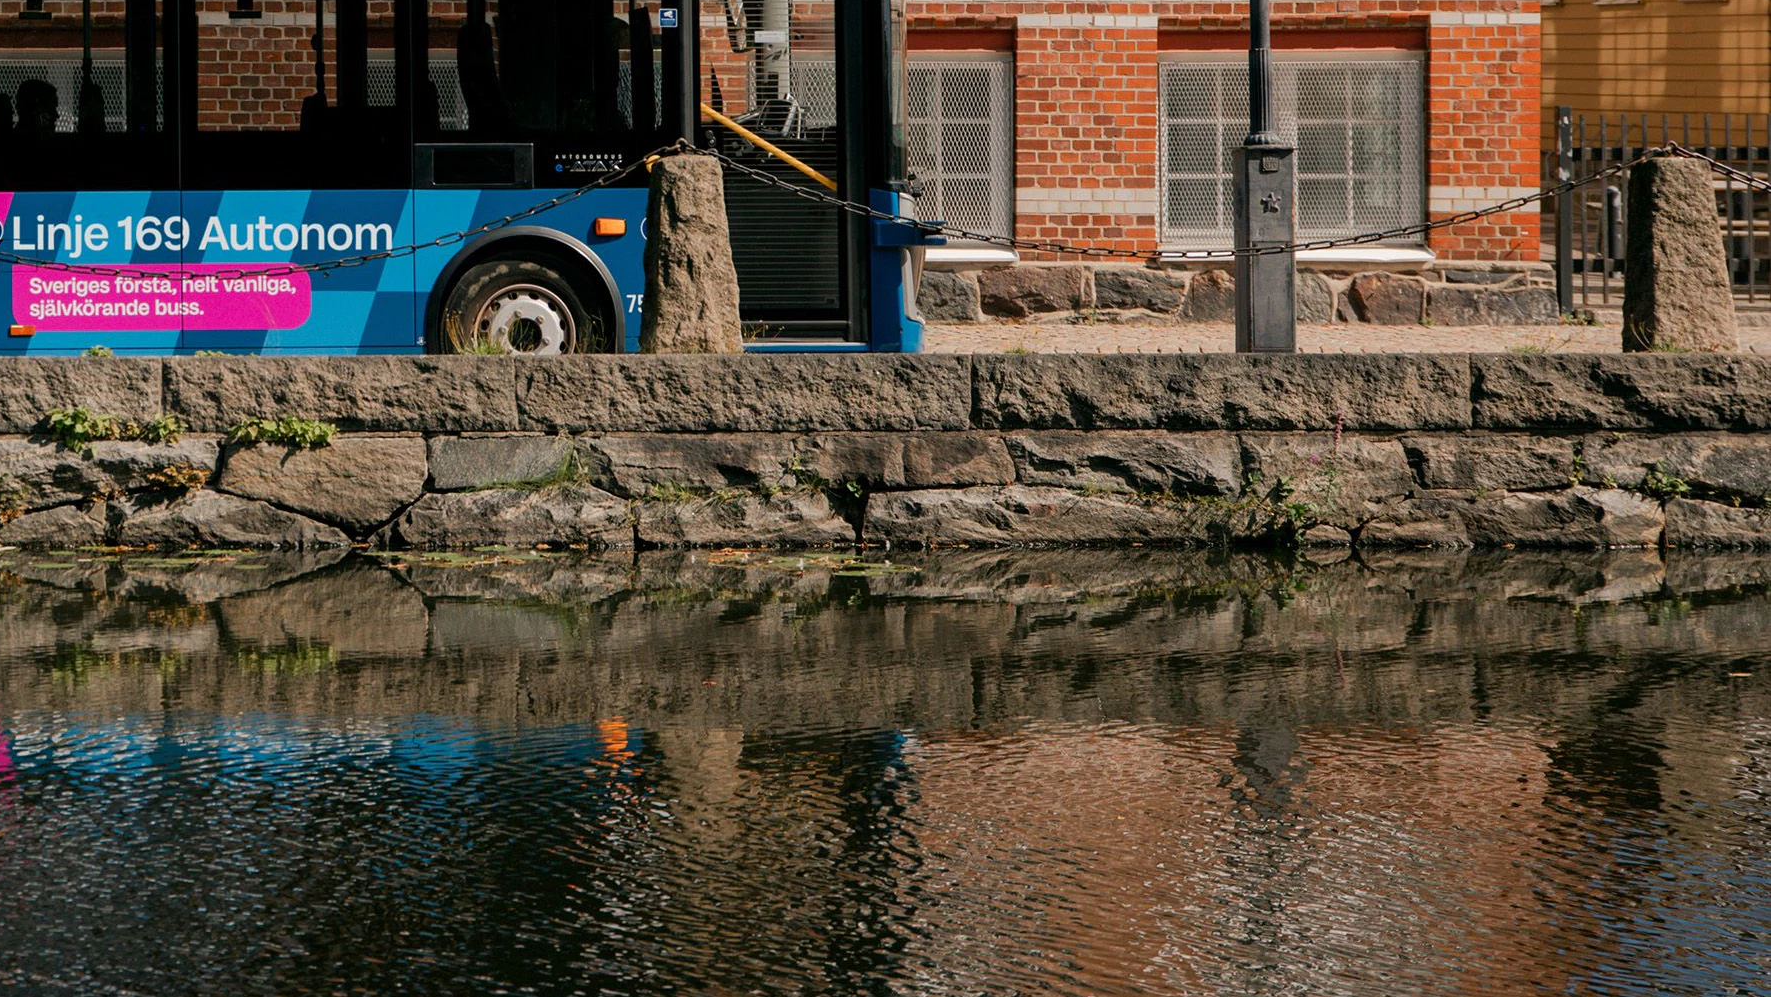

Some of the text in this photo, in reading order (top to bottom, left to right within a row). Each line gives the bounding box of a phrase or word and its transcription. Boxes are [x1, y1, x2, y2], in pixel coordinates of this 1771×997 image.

[13, 214, 393, 259] Linje 169 Autonom
[29, 275, 296, 297] Sveriges första, helt vanliga,
[29, 299, 204, 320] självkörande buss.
